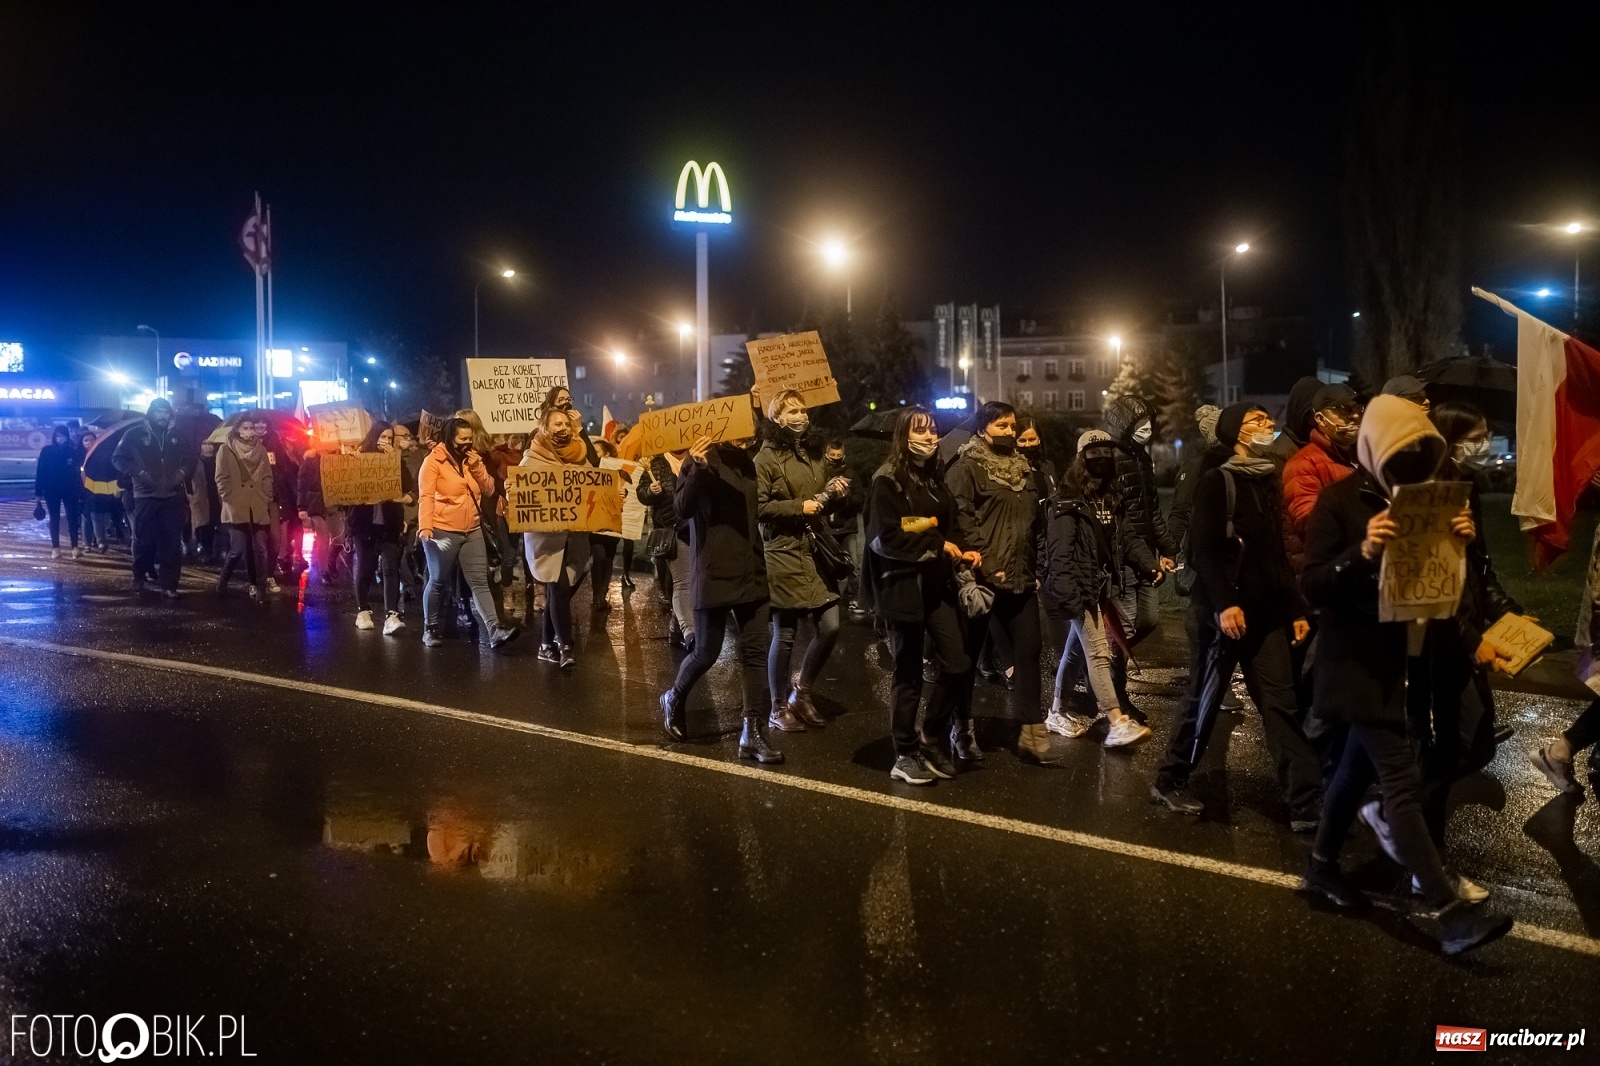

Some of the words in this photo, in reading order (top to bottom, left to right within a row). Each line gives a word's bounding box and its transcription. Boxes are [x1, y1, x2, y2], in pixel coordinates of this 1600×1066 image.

[493, 365, 509, 376] BEZ
[512, 364, 541, 376] KOBIET
[473, 378, 505, 390] DALEKO
[508, 377, 522, 389] NIE
[525, 375, 567, 392] ZAJDZIECIE
[498, 393, 515, 405] BEZ
[517, 392, 548, 404] KOBIET
[664, 400, 734, 427] WOMAN
[679, 416, 730, 444] KRAJ
[515, 471, 557, 488] MOJA
[563, 470, 613, 487] BROSZKA
[517, 489, 541, 504] NIE
[545, 486, 582, 505] TWÓJ
[517, 506, 578, 524] INTERES
